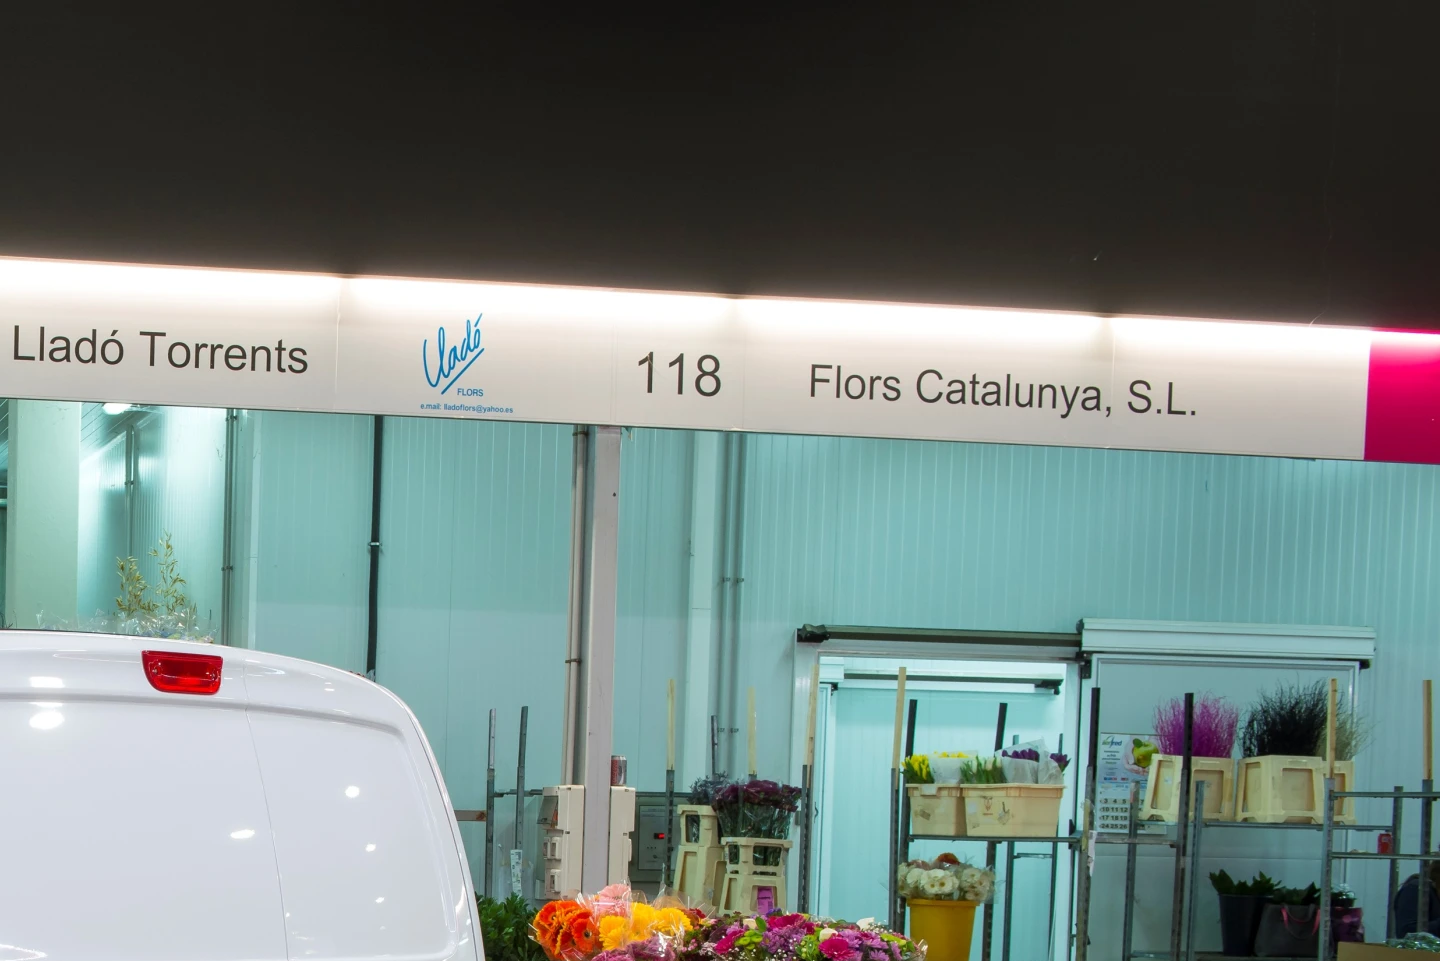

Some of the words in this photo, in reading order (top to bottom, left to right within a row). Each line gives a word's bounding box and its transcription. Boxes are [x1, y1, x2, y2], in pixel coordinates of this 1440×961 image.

[13, 325, 124, 366] Lladó
[139, 331, 308, 374] Torrents
[457, 388, 484, 397] FLORS
[638, 351, 722, 397] 118
[810, 364, 901, 402] Flors
[916, 369, 1112, 418] Catalunya,
[1127, 379, 1196, 416] S.L.
[444, 403, 513, 414] lladoflors@yahoo.es
